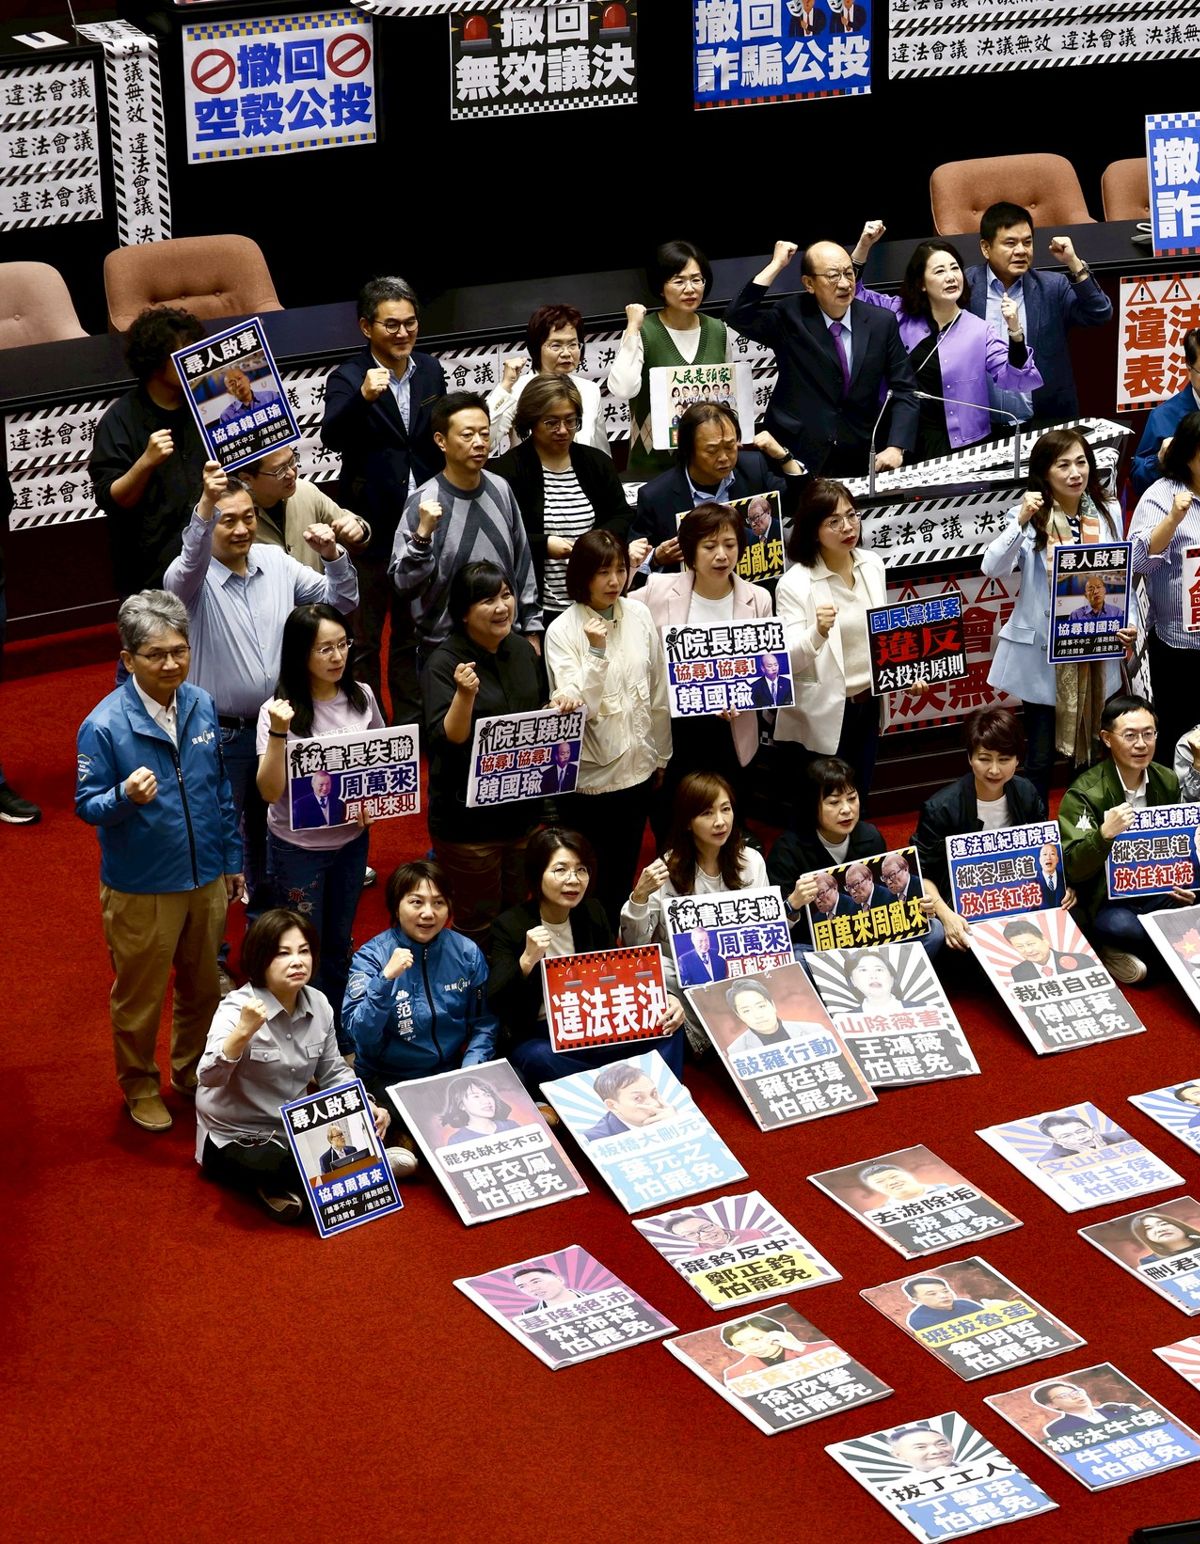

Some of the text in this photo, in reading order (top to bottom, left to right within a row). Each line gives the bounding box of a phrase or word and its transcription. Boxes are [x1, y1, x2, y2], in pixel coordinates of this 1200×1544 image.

[501, 0, 588, 48] 撤回
[696, 0, 781, 44] 撤回
[892, 40, 968, 64] 違法會議
[977, 34, 1051, 57] 決議無效
[1061, 28, 1137, 51] 違法會議
[238, 39, 325, 89] 撤回
[455, 43, 635, 101] 無效議決
[696, 36, 870, 93] 詐騙公投
[5, 76, 91, 106] 違法會議
[122, 42, 155, 216] 決議無效 違法會議
[194, 82, 371, 141] 空殼公投
[9, 129, 94, 158] 違法會議
[13, 183, 97, 213] 違法會議
[184, 330, 257, 374] 尋人啟事
[212, 404, 282, 444] 協尋韓國瑜
[872, 514, 964, 549] 違法會議
[1061, 550, 1125, 569] 尋人啟事
[870, 597, 961, 633] 國民黨提案
[1058, 620, 1120, 636] 協尋韓國瑜
[681, 623, 785, 659] 院長蹺班
[877, 620, 961, 666] 違反
[674, 659, 757, 684] 協尋! 協尋!
[878, 654, 965, 691] 公投法原則
[677, 680, 754, 714] 韓國瑜
[493, 712, 583, 750] 院長蹺班
[480, 748, 551, 773] 協尋! 協尋!
[339, 764, 417, 800] 周萬來
[477, 771, 543, 804] 韓國瑜
[950, 825, 1059, 859] 違法亂紀韓院長
[1113, 835, 1191, 863] 縱容黑道
[956, 855, 1037, 889] 縱容黑道
[1115, 862, 1195, 891] 放任紅統
[960, 883, 1043, 918] 放任紅統
[718, 924, 788, 958] 周萬來
[552, 979, 666, 1043] 違法表決
[840, 1010, 942, 1034] 山除薇害
[1047, 1012, 1130, 1045] 怕罷免
[733, 1036, 838, 1077] 敲羅行動
[856, 1032, 944, 1059] 王鴻薇
[756, 1061, 846, 1099] 羅廷瑋
[864, 1053, 954, 1080] 怕罷免
[291, 1089, 361, 1129] 尋人啟事
[769, 1083, 858, 1120] 怕罷免
[463, 1156, 556, 1191] 謝衣鳳
[619, 1146, 710, 1180] 葉元之
[318, 1169, 383, 1204] 協尋周萬來
[476, 1179, 568, 1210] 怕罷免
[633, 1164, 725, 1201] 怕罷免
[1084, 1169, 1170, 1198] 怕罷免
[872, 1187, 977, 1224] 去游除垢
[912, 1215, 1004, 1248] 怕罷免
[718, 1268, 812, 1299] 怕罷免
[545, 1306, 640, 1343] 林沛祥
[559, 1320, 655, 1355] 怕罷免
[948, 1320, 1040, 1355] 魯明哲
[964, 1336, 1059, 1371] 怕罷免
[774, 1381, 873, 1422] 怕罷免
[1090, 1445, 1191, 1480] 怕罷免
[892, 1462, 1013, 1502] 拔丁工人
[916, 1480, 1022, 1516] 丁學忠
[934, 1495, 1038, 1532] 怕罷免
